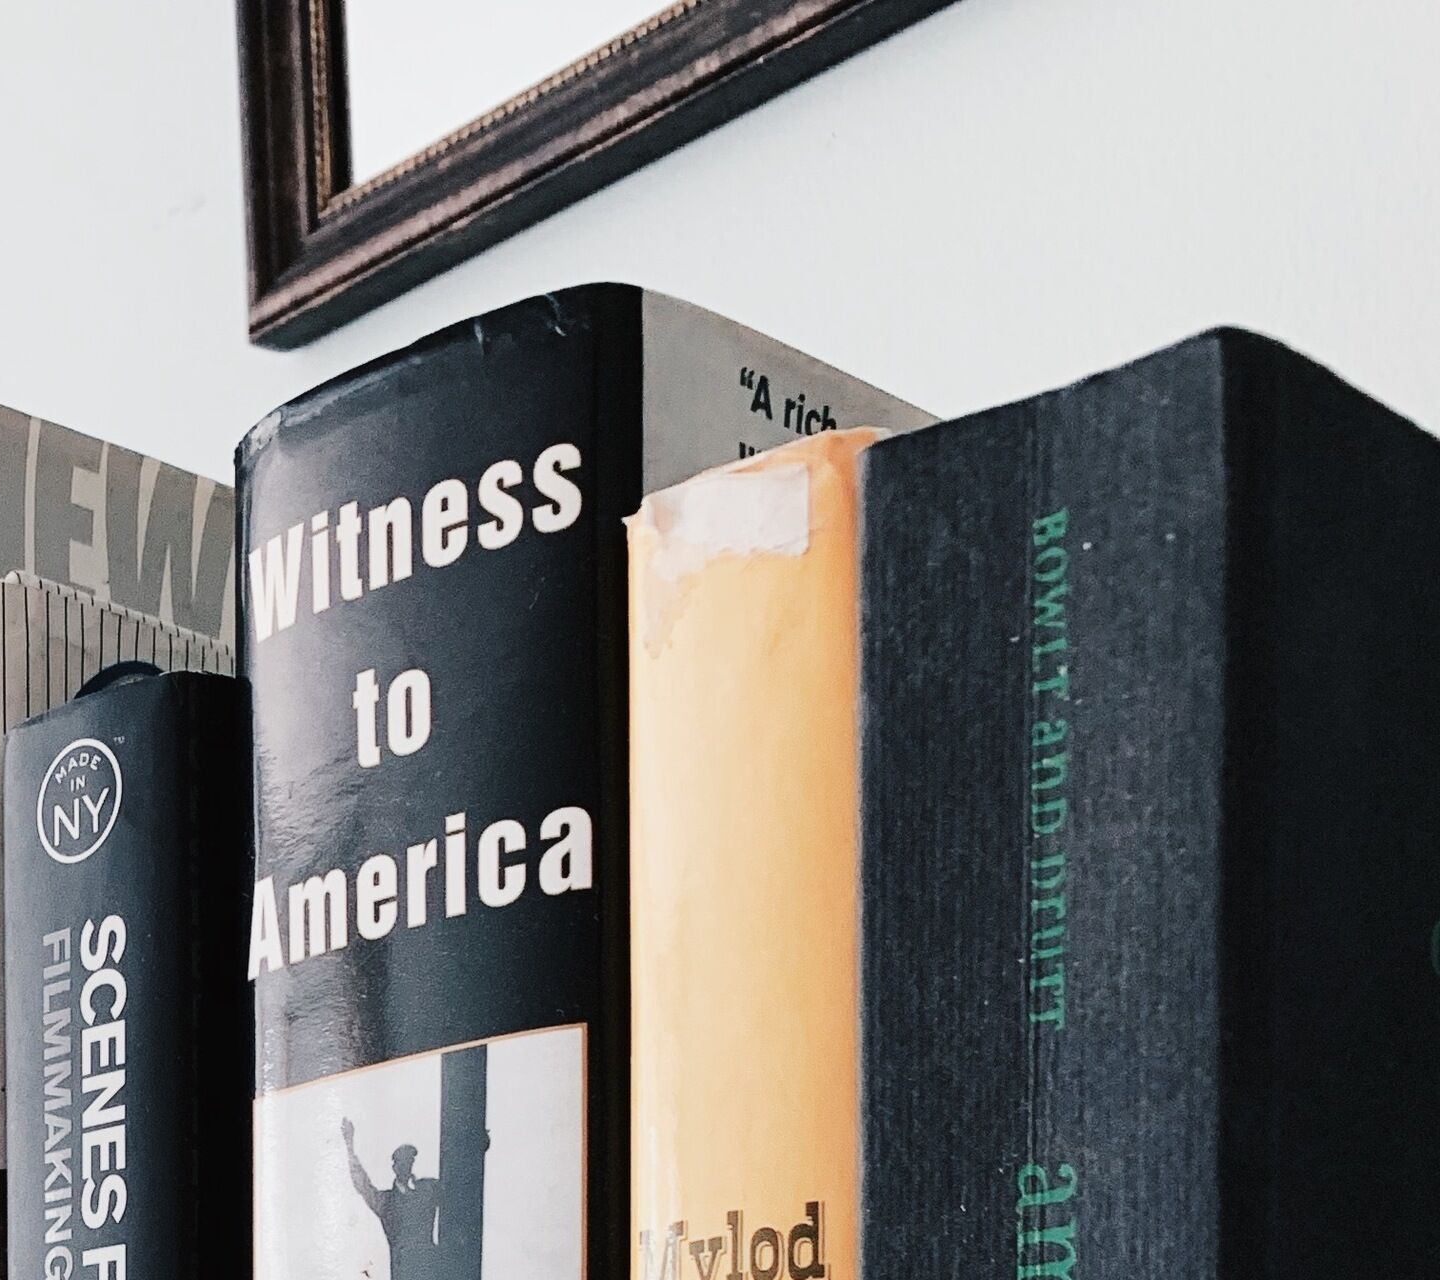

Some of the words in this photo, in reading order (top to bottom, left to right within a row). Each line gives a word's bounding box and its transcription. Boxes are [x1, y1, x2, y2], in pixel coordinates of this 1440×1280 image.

[783, 393, 837, 436] rich
[248, 443, 582, 643] Witness
[353, 668, 432, 769] to
[54, 752, 102, 784] MADE
[70, 775, 86, 792] IN
[54, 787, 110, 847] NY
[247, 806, 594, 981] America
[80, 914, 127, 1230] SCENES
